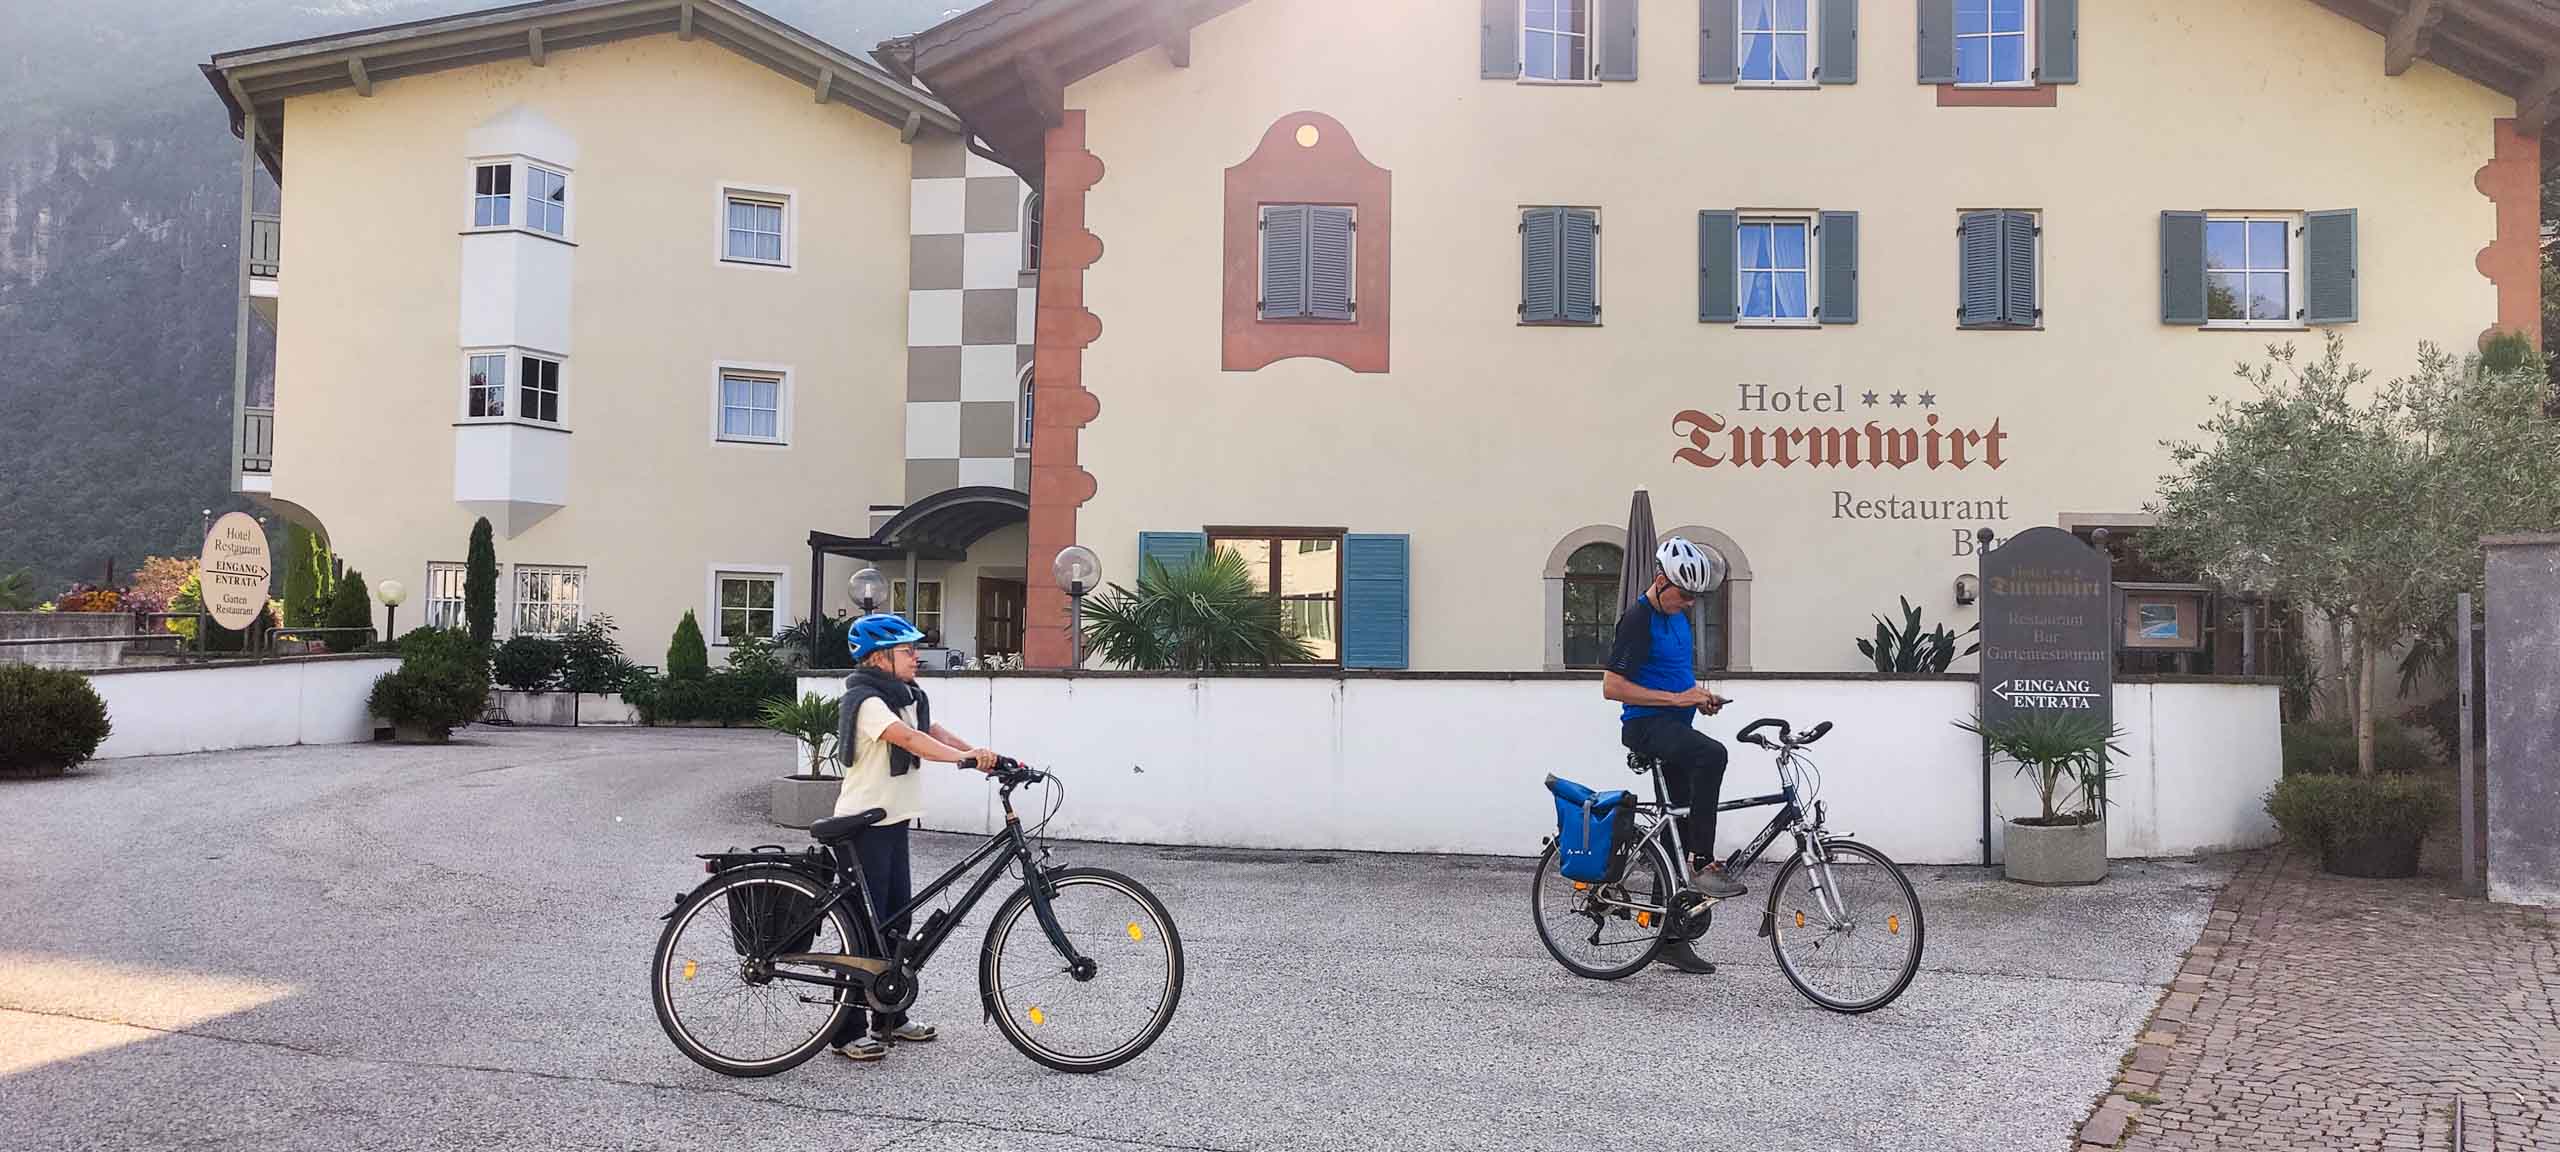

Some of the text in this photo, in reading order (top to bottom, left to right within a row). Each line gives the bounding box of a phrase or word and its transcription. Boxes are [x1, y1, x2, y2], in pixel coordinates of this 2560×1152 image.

[1738, 384, 1846, 412] Hotel
[1672, 409, 2007, 470] Turmwirt
[1832, 491, 2008, 520] Restaurant
[226, 528, 251, 541] Hotel
[215, 539, 261, 555] Restaurant
[216, 561, 258, 574] EINGANG
[215, 575, 257, 587] ENTRATA
[223, 594, 247, 604] Garten
[216, 604, 253, 615] Restaurant
[2008, 610, 2083, 625] Restaurant
[2033, 629, 2059, 643] Bar
[1987, 646, 2105, 661] Gartenrestaurant
[2014, 679, 2090, 693] EINGANG
[2014, 696, 2090, 709] ENTRATA
